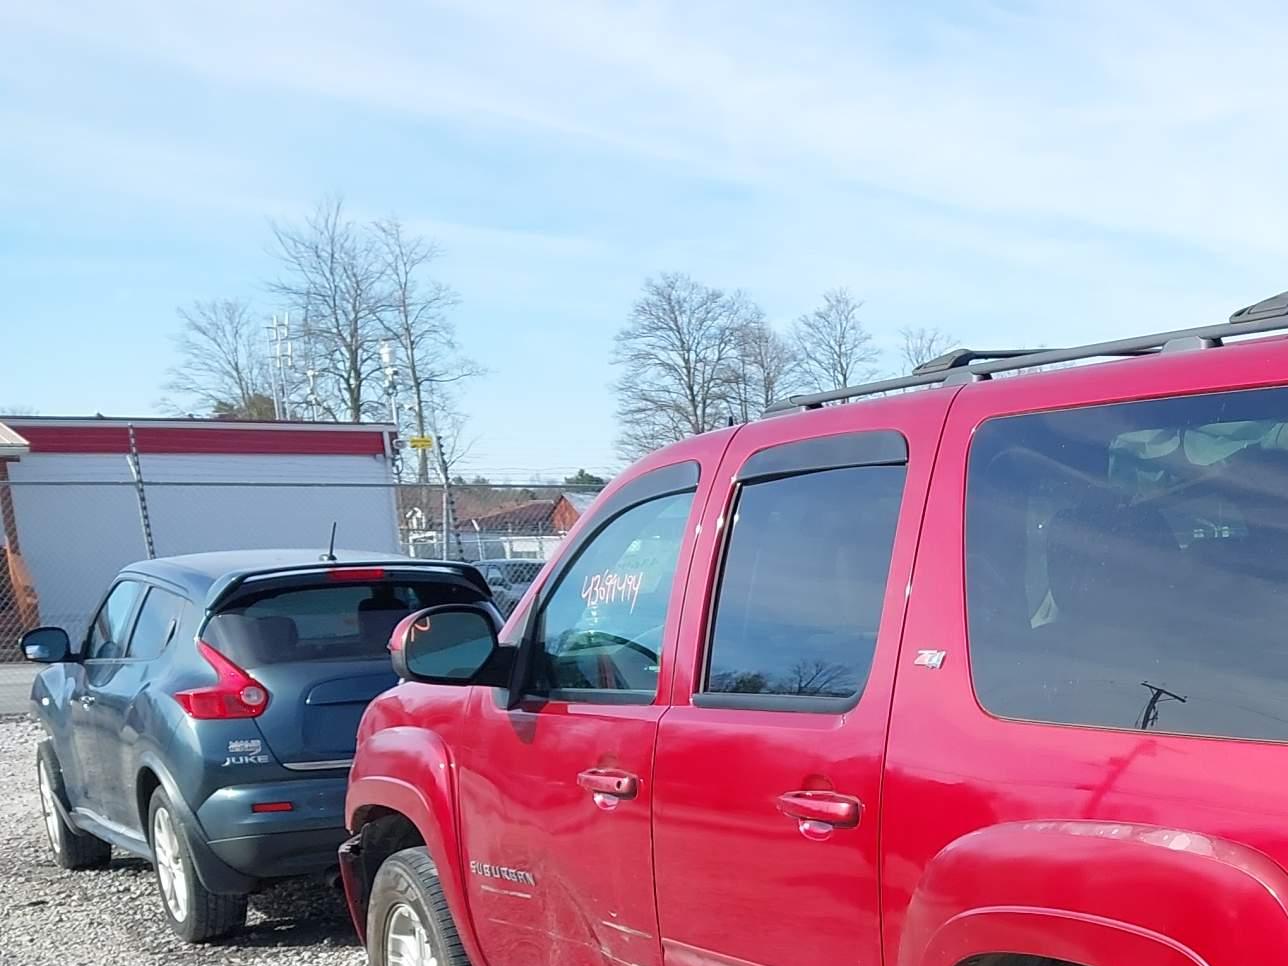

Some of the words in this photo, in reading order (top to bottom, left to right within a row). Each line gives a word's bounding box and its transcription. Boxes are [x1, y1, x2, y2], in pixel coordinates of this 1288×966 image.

[581, 568, 644, 615] 43699494
[221, 755, 269, 767] JUKE
[469, 860, 537, 887] SUBURBAN
